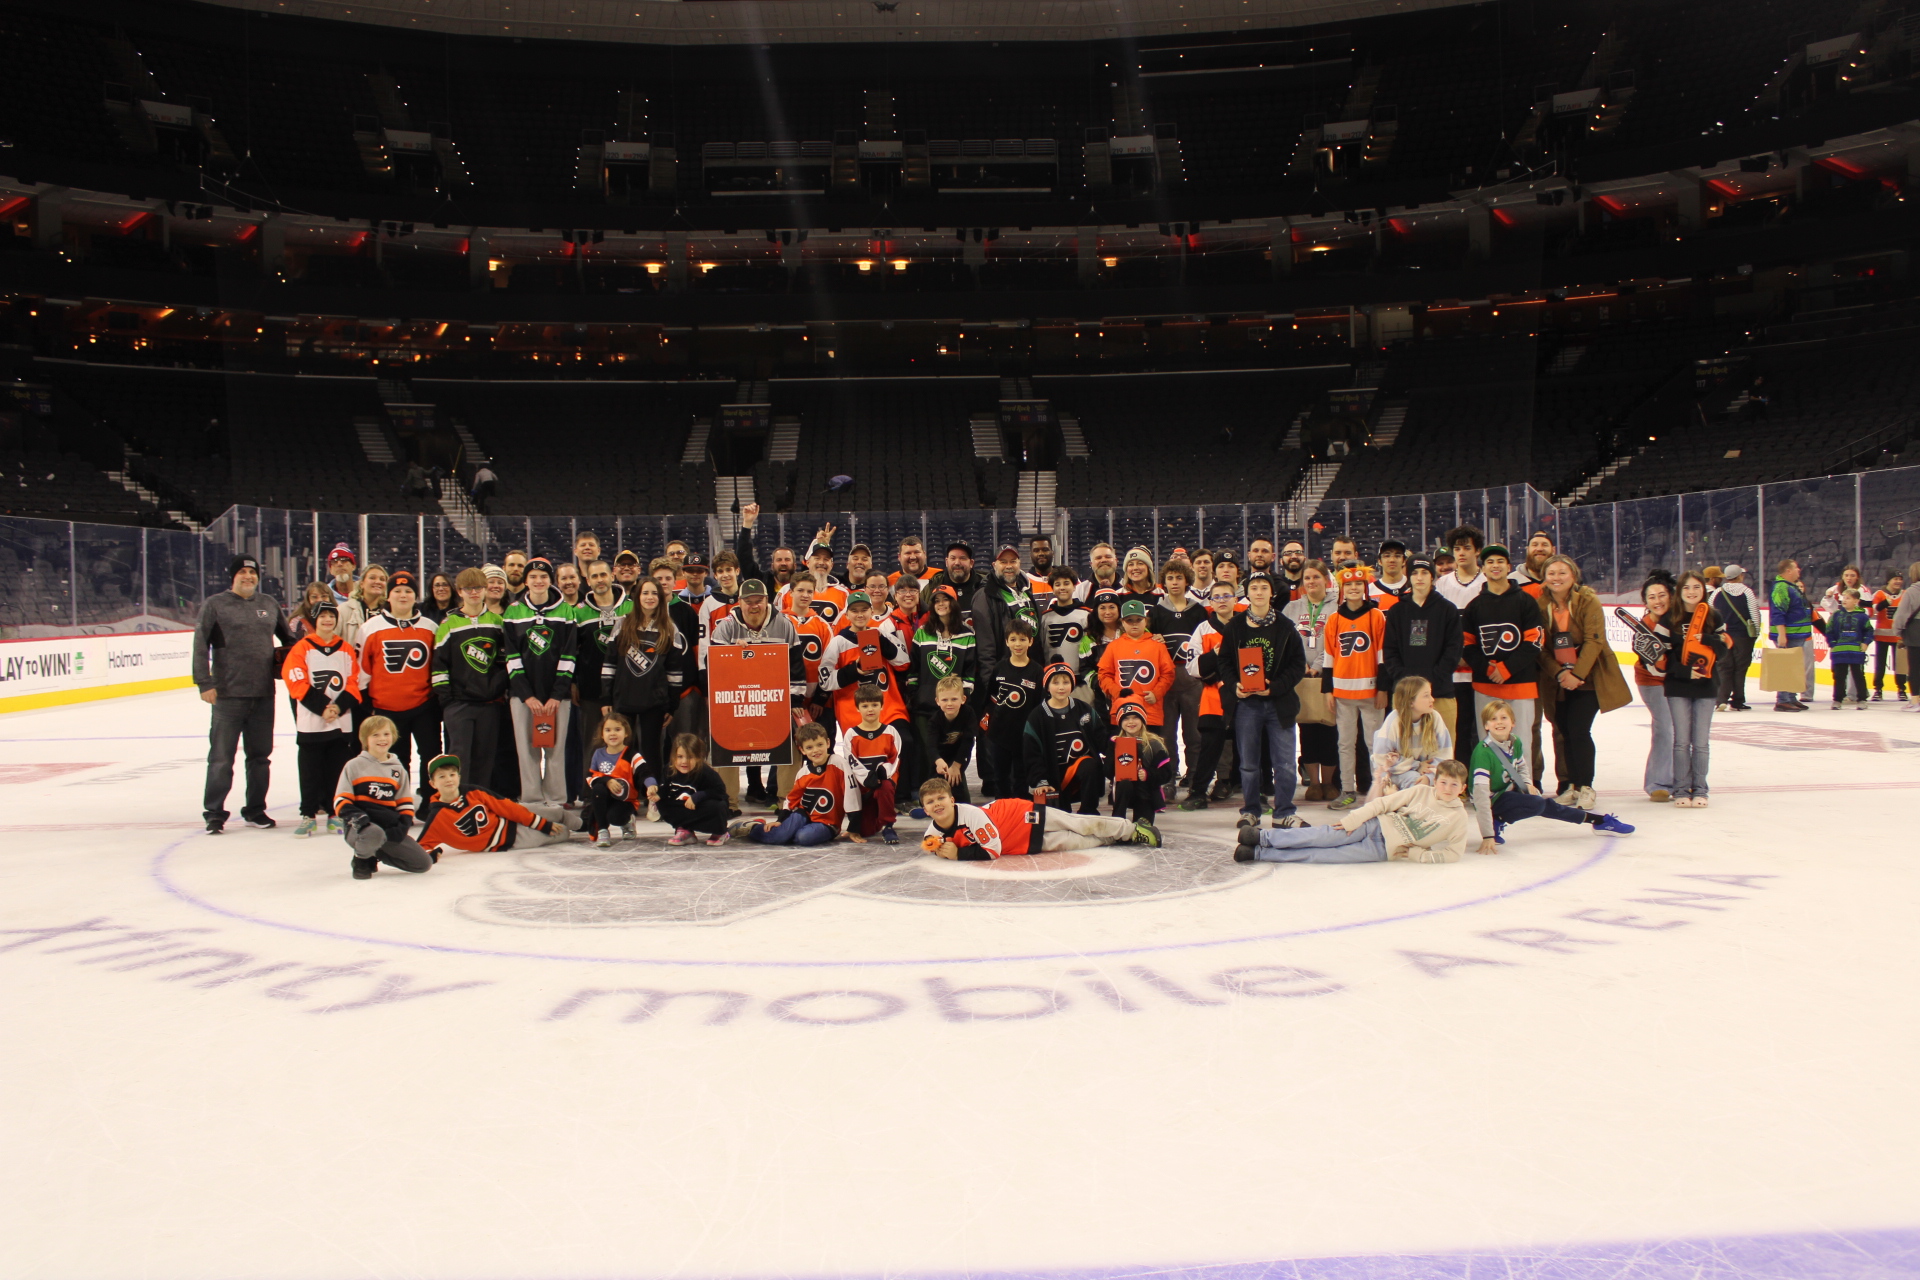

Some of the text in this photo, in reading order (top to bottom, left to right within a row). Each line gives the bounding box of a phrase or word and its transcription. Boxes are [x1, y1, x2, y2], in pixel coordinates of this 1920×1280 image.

[529, 631, 547, 650] RHL
[108, 651, 143, 669] Holman
[466, 644, 489, 665] RHL
[627, 645, 649, 670] RHL
[0, 656, 24, 682] LAY
[26, 660, 38, 675] TO
[40, 652, 71, 678] WIN!
[930, 656, 947, 674] RHL
[289, 667, 305, 683] 46
[715, 689, 784, 704] RIDLEY HOCKEY
[733, 703, 767, 718] LEAGUE
[750, 753, 771, 762] BRICK
[848, 774, 858, 789] 11
[975, 822, 998, 845] 88
[1394, 873, 1780, 981] ARENA
[540, 963, 1350, 1026] mobile
